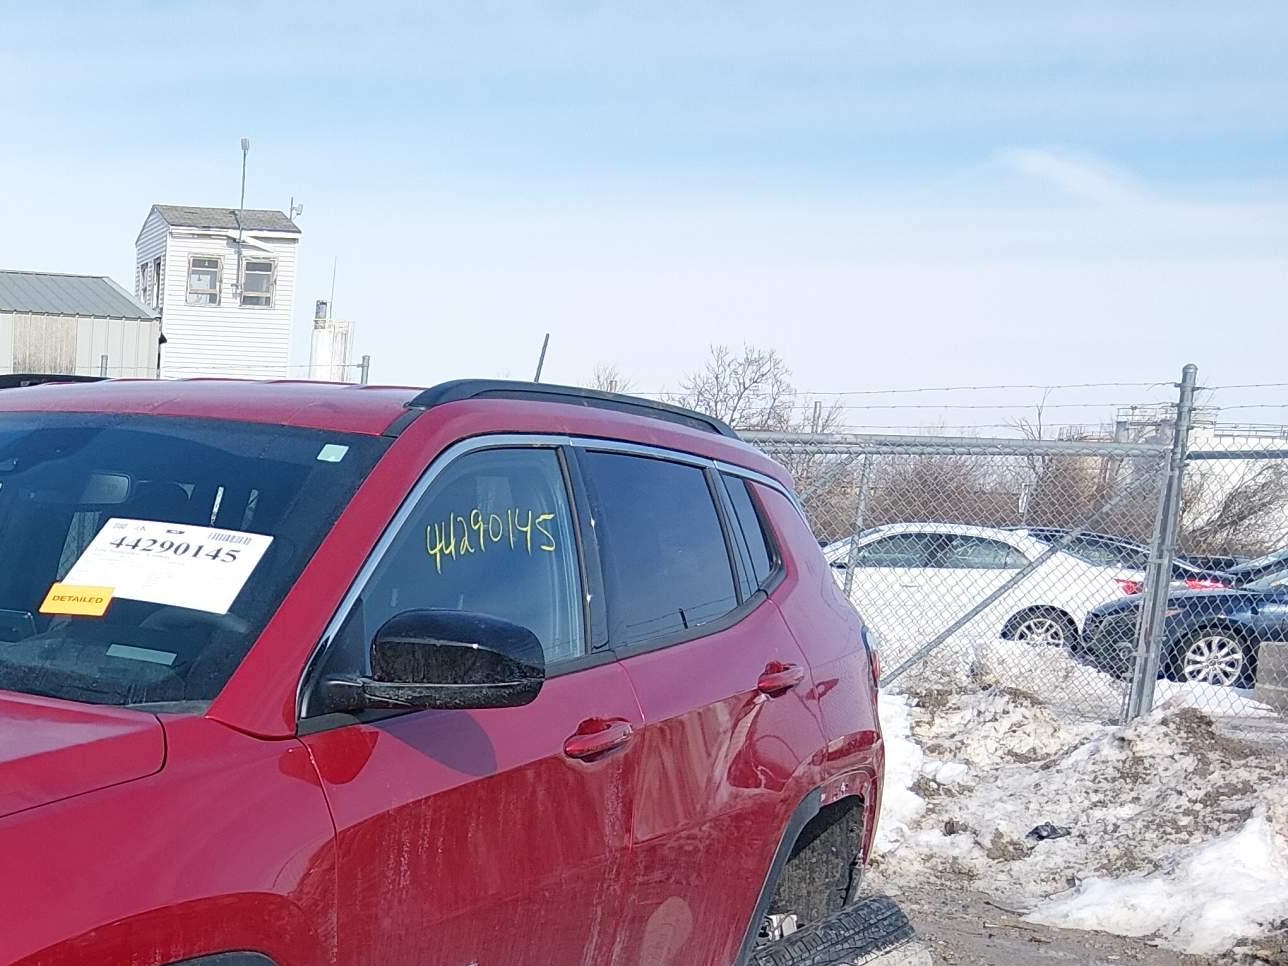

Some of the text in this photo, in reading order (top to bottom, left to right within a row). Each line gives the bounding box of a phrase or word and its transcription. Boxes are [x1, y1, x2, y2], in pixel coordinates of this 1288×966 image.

[109, 535, 241, 563] 44290145
[426, 508, 556, 574] 44290145
[52, 594, 104, 604] DETAILED
